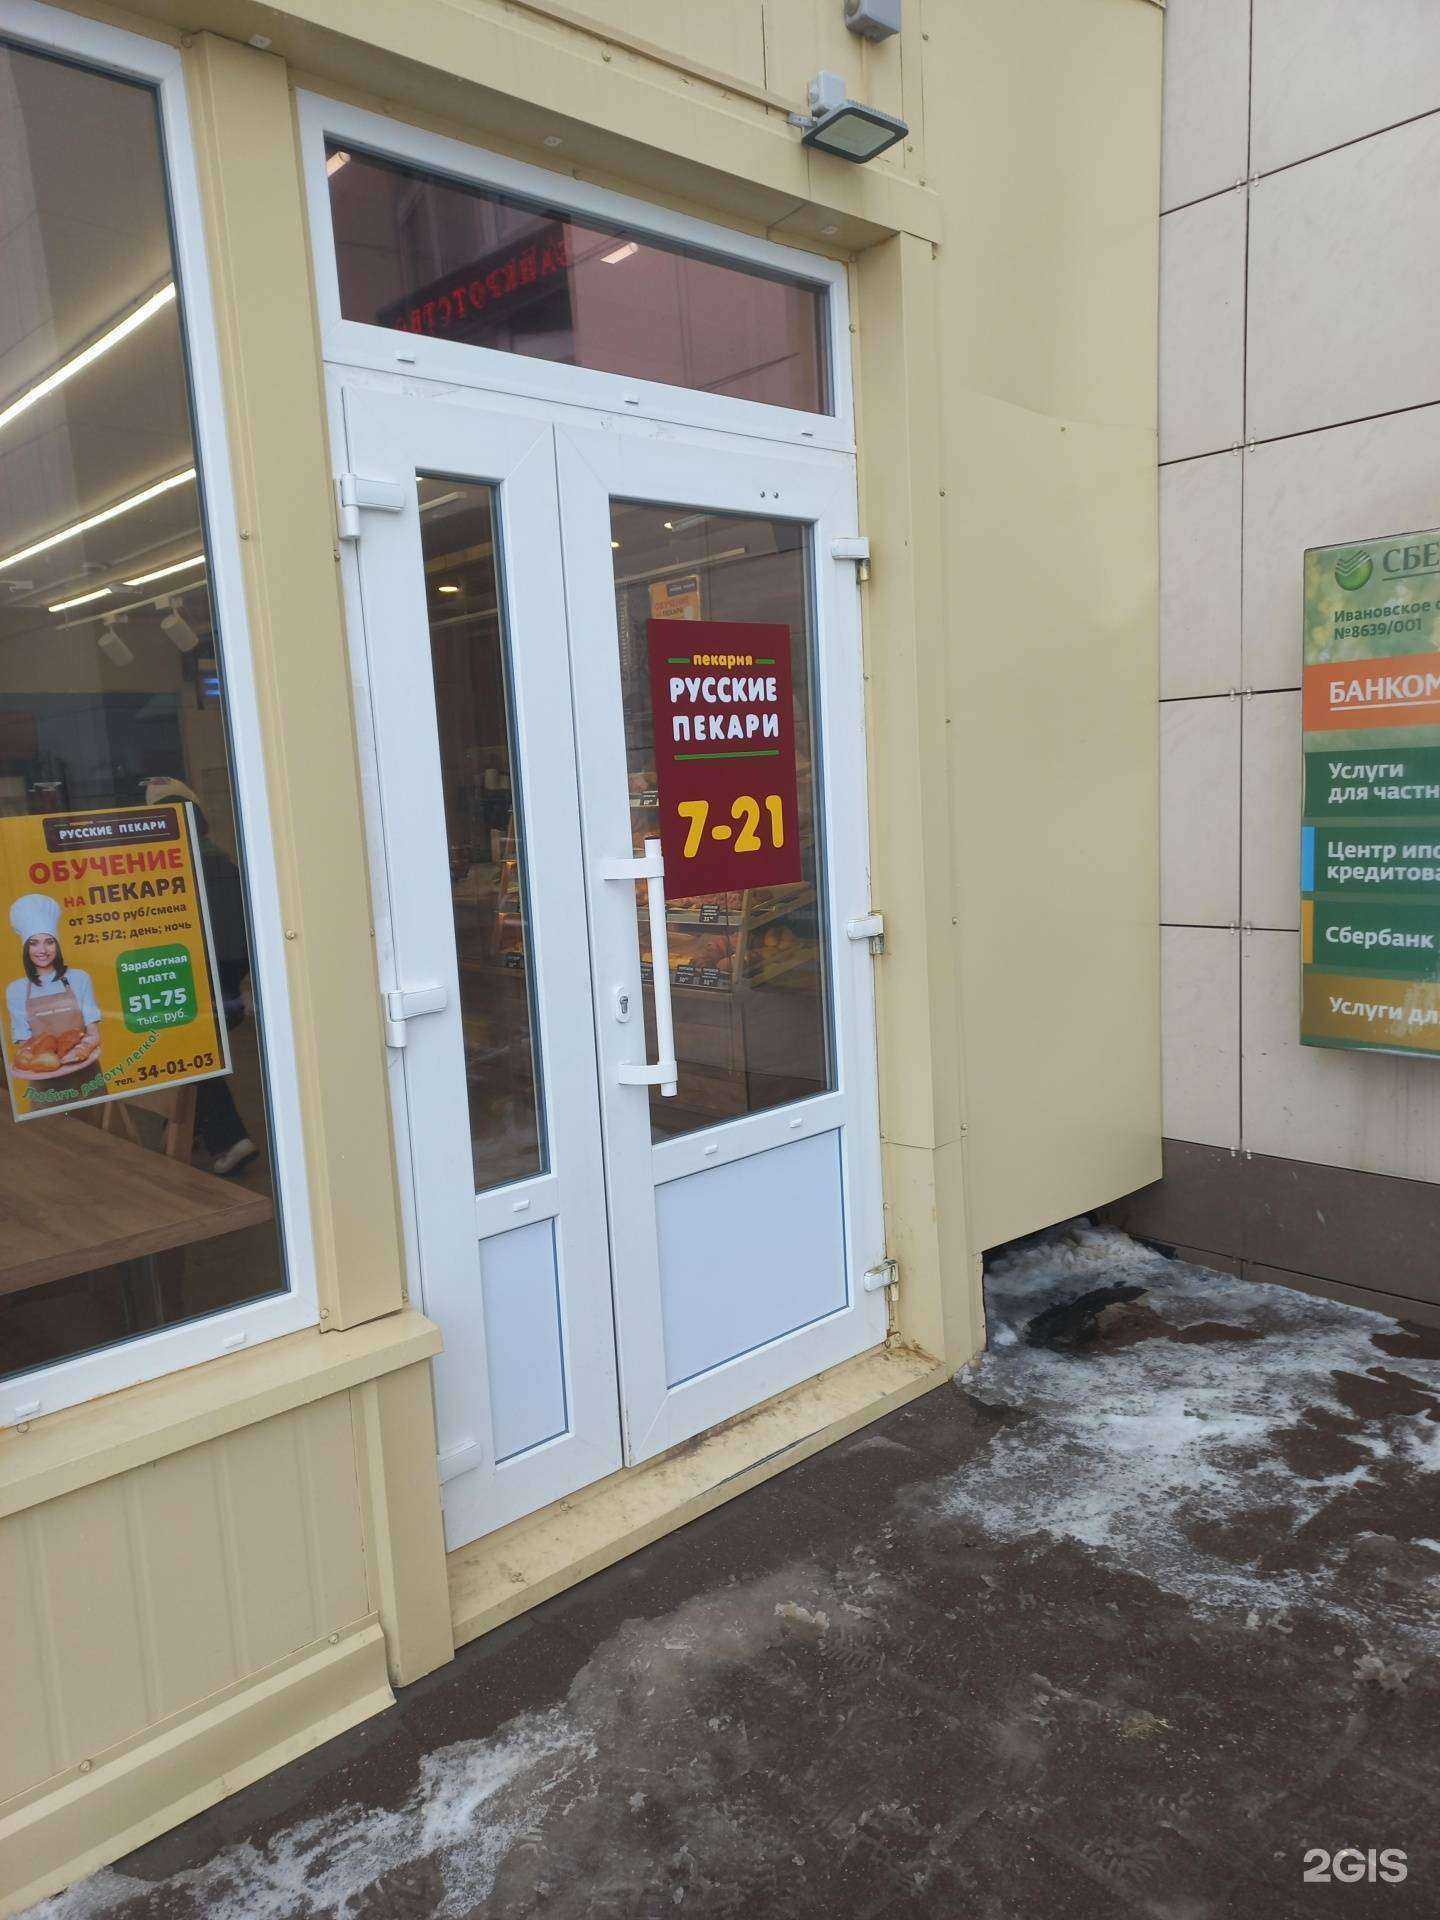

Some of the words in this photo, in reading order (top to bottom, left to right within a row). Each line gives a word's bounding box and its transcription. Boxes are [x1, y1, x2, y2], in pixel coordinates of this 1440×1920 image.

[1382, 542, 1440, 573] СБЕ
[1334, 600, 1431, 623] Ивановское
[1333, 618, 1422, 641] №8639/001
[693, 653, 753, 668] пекарня
[668, 676, 778, 704] РУССКИЕ
[671, 712, 780, 742] ПЕКАРИ
[1328, 762, 1404, 783] Услуги
[1328, 785, 1369, 805] для
[1373, 783, 1440, 801] частн
[58, 825, 113, 840] РУССКИЕ
[118, 820, 166, 834] ПЕКАРИ
[677, 794, 785, 858] 7-21
[1327, 841, 1397, 863] Центр
[28, 848, 185, 885] ОБУЧЕНИЕ
[88, 876, 186, 906] ПЕКАРЯ
[68, 917, 84, 927] от
[87, 911, 120, 925] 3500
[123, 903, 187, 922] руб/смена
[164, 921, 192, 933] ночь
[1325, 926, 1434, 949] Сбербанк
[120, 954, 188, 973] Заработная
[138, 971, 177, 985] плата
[128, 987, 187, 1013] 51-75
[1328, 995, 1402, 1023] Услуги
[136, 1014, 161, 1026] тыс.
[114, 1075, 136, 1088] тел.
[137, 1053, 215, 1082] 34-01-03
